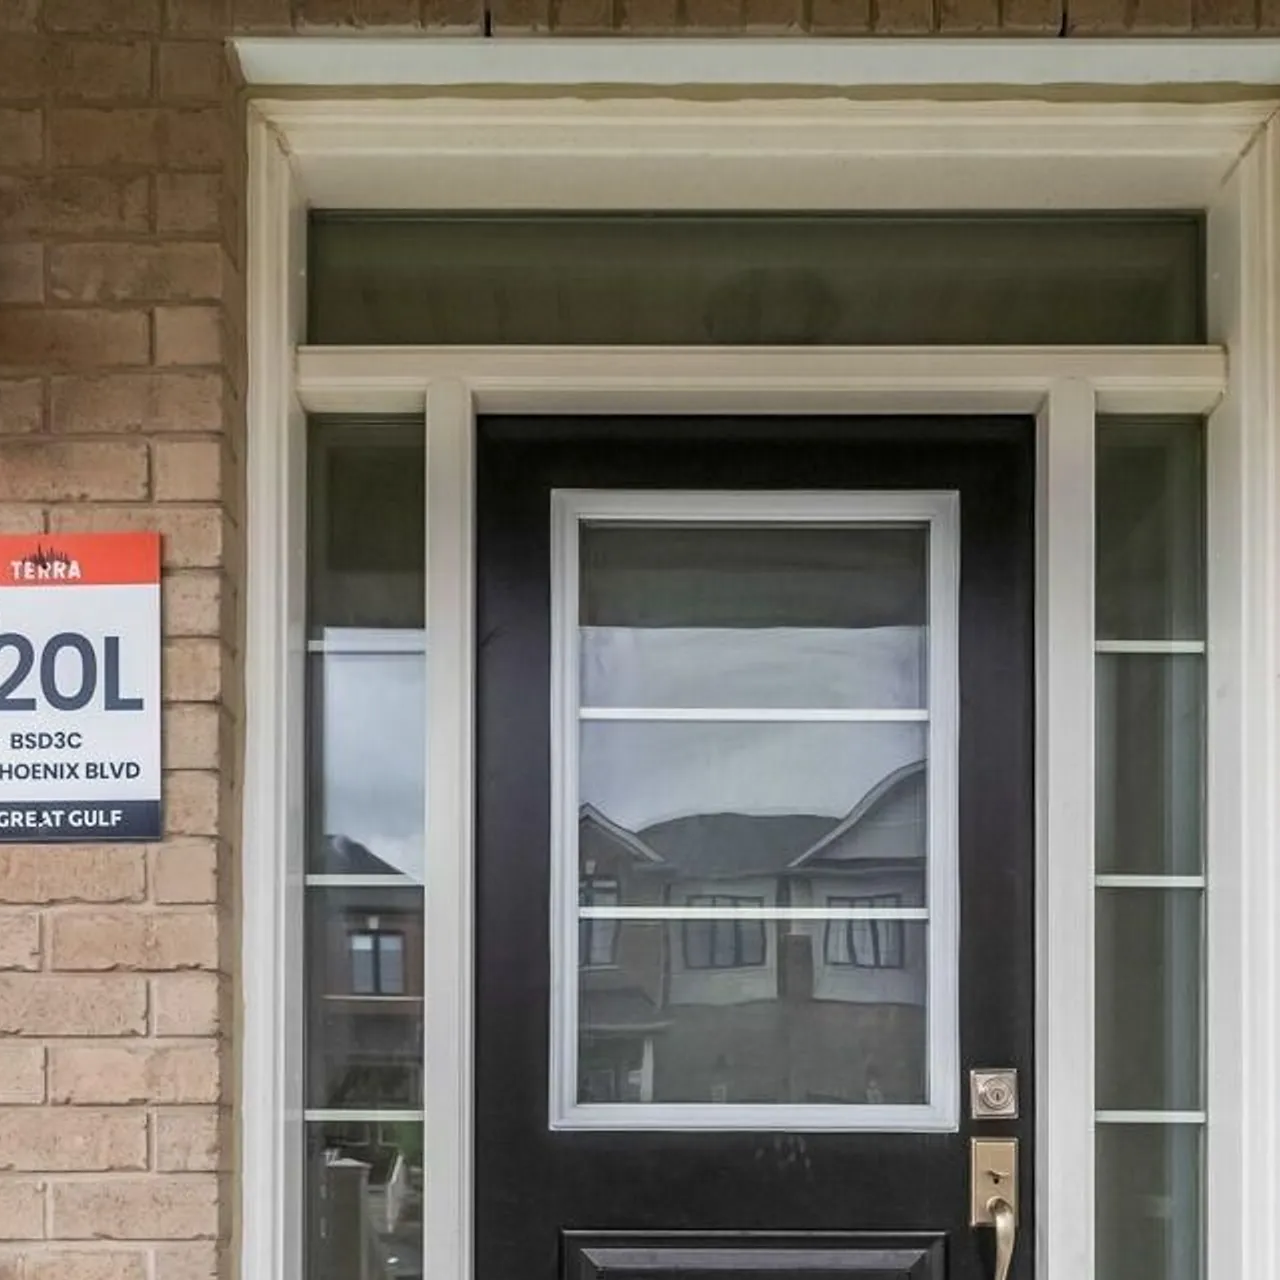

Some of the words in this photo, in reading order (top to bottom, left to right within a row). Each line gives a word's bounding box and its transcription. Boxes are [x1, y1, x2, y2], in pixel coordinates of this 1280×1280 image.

[10, 560, 82, 580] TERRA
[10, 732, 82, 750] BSD3C
[85, 761, 141, 780] BLVD
[67, 809, 123, 827] GULF
